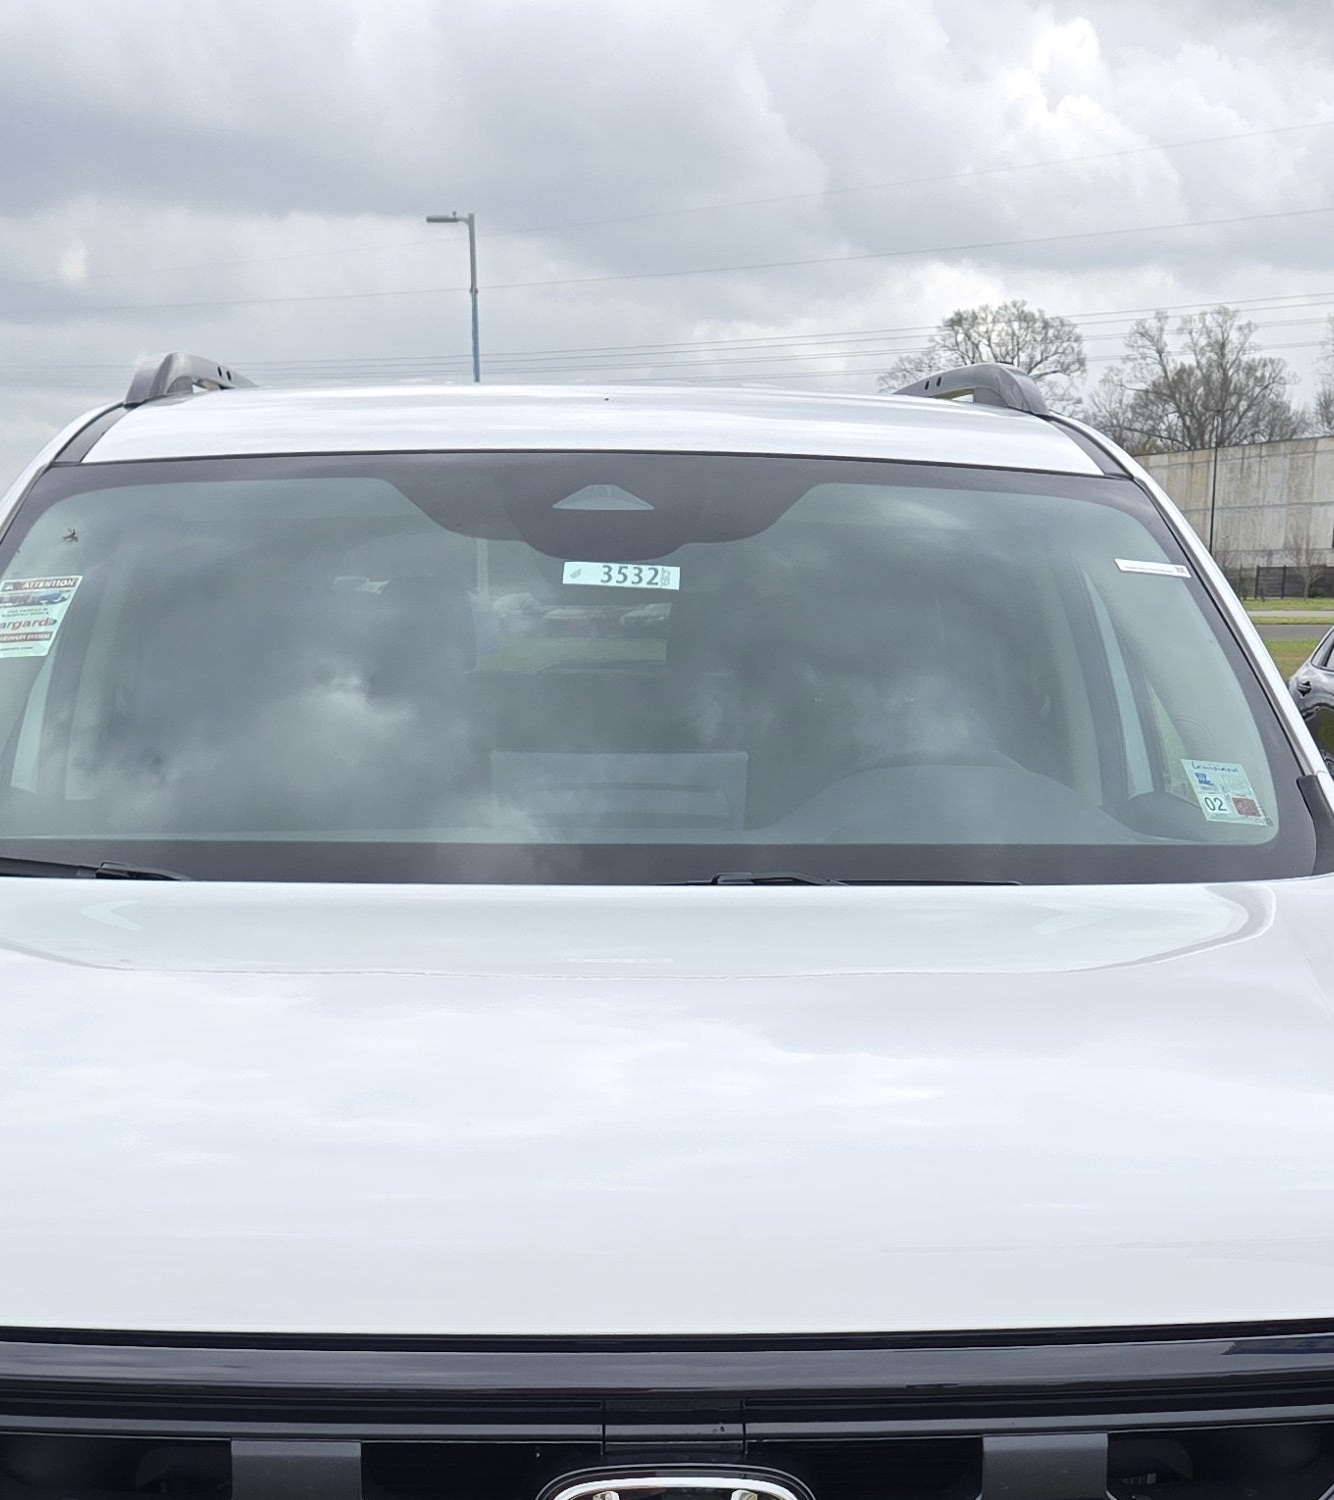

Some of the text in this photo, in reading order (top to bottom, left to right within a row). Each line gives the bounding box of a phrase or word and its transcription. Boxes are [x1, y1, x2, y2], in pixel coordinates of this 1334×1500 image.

[600, 565, 659, 586] 3532
[21, 579, 75, 589] ATTENTION
[1204, 796, 1227, 811] 02
